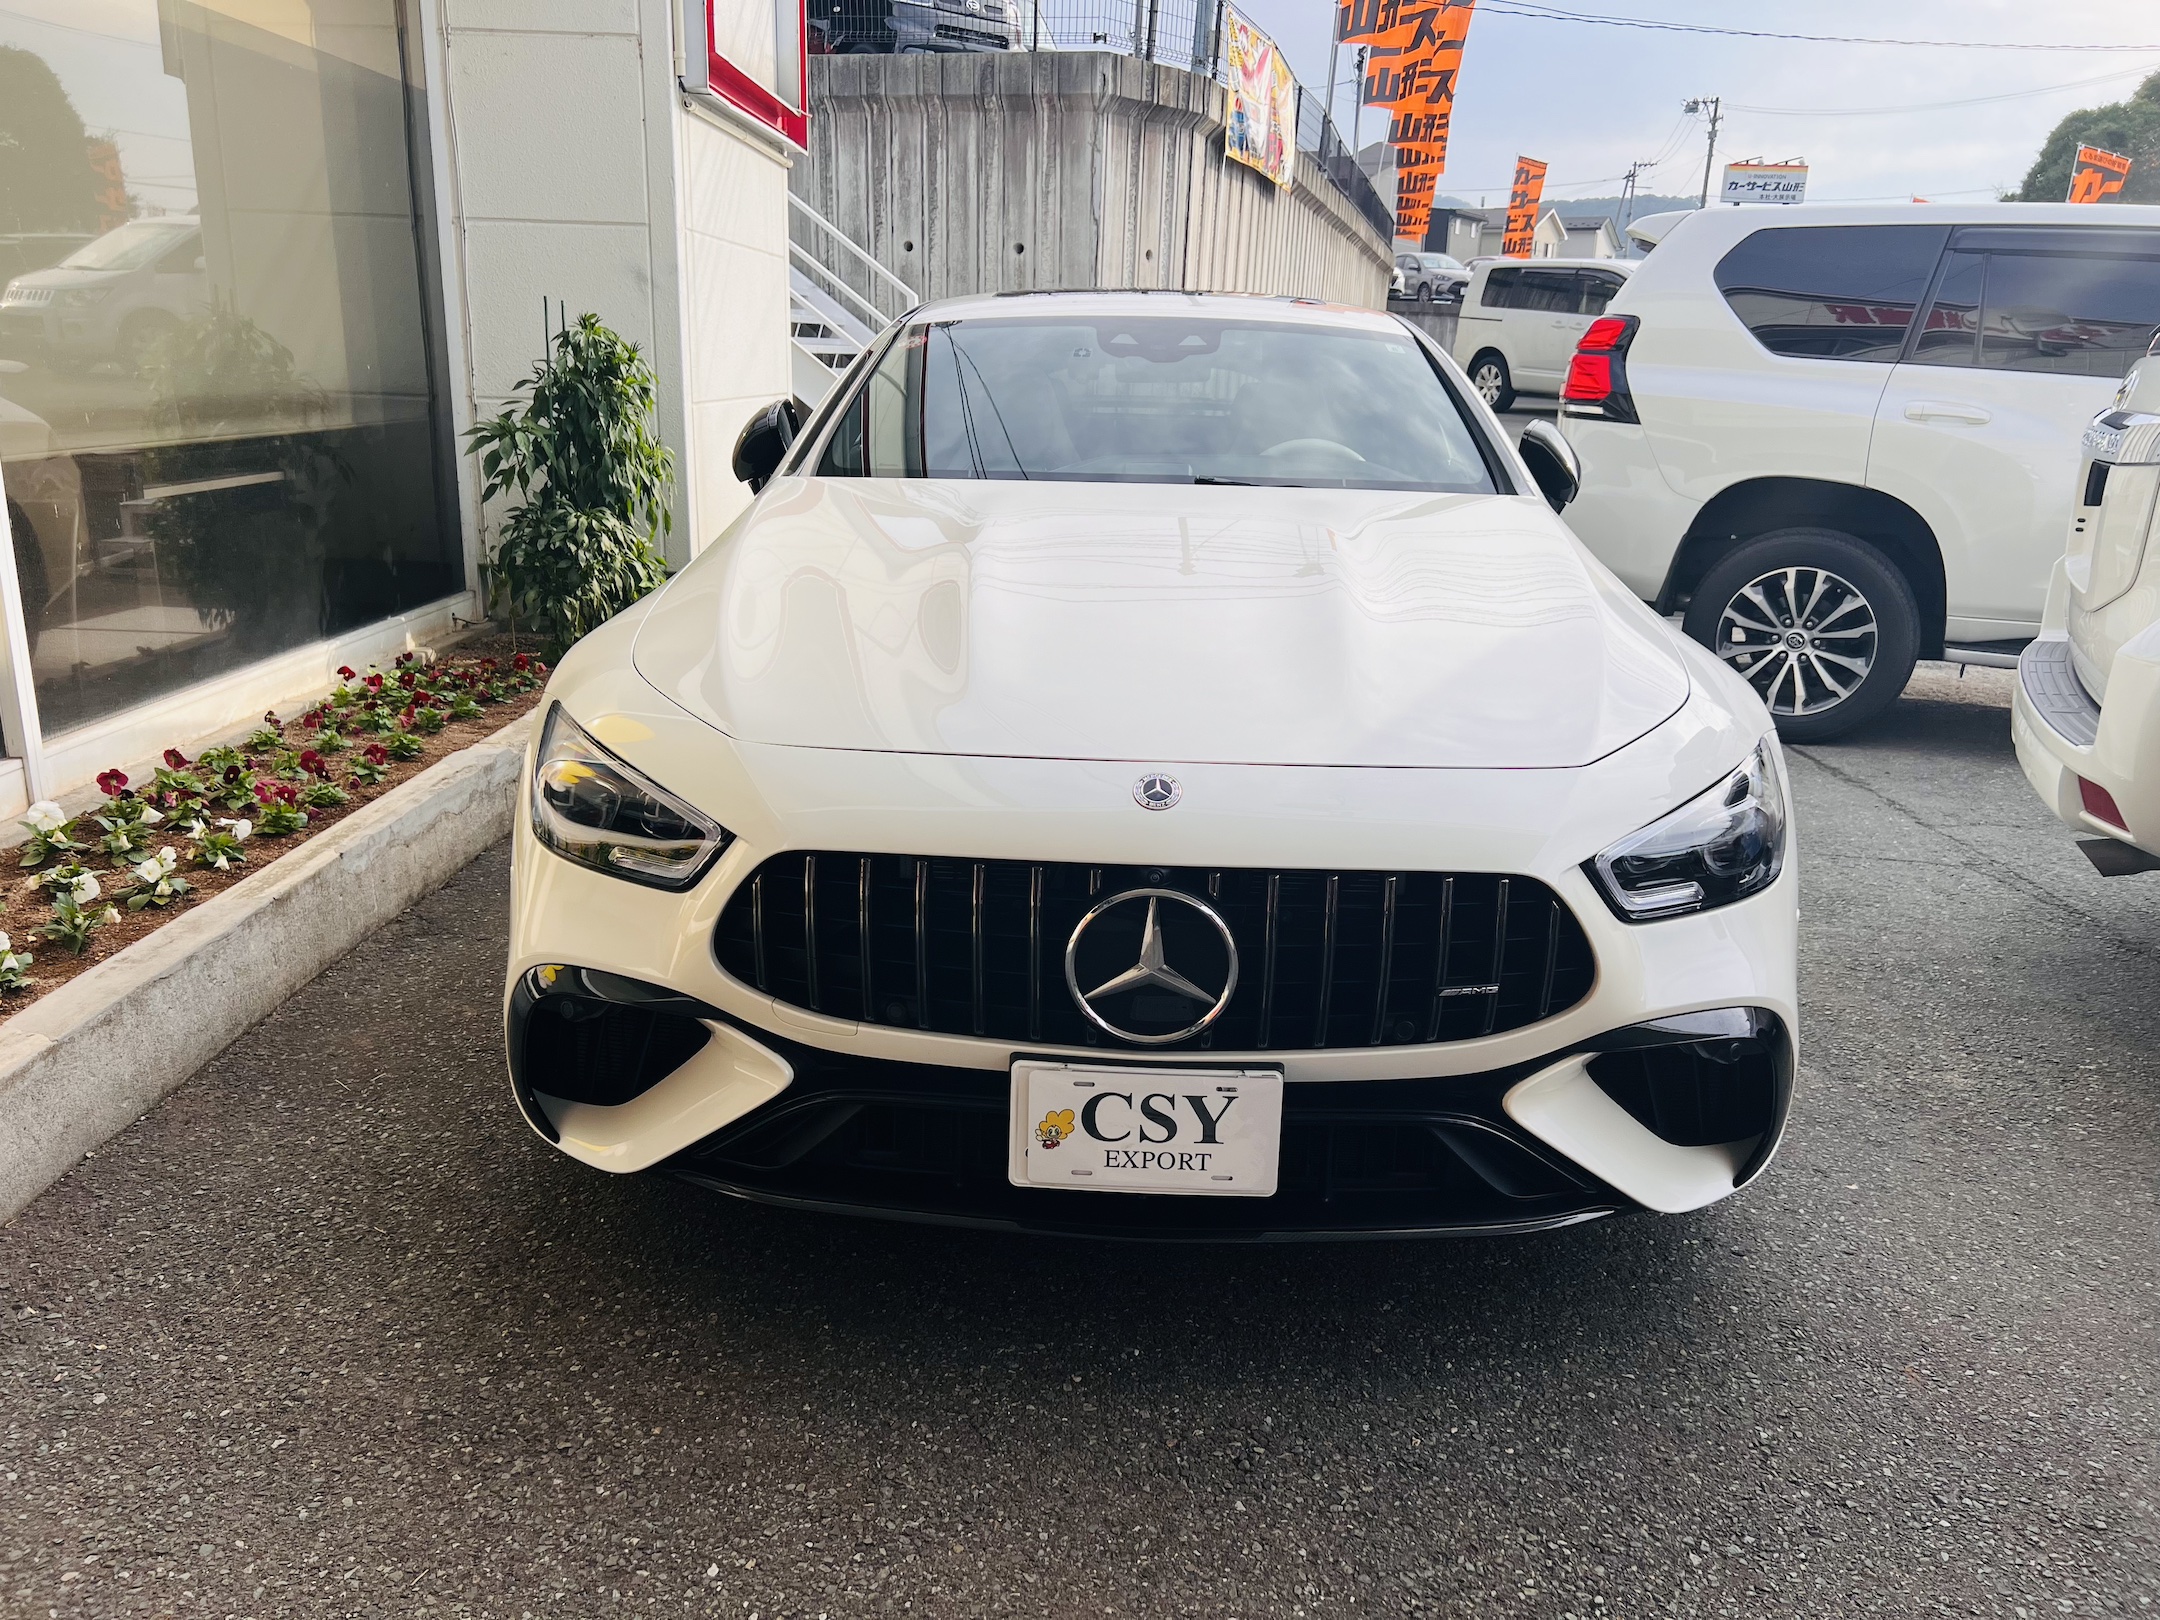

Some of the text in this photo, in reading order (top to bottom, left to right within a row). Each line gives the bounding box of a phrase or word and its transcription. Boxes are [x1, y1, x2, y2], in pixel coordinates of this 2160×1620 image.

[1728, 180, 1805, 192] カーサービス山形
[1080, 1091, 1239, 1145] CSY
[1104, 1149, 1212, 1172] EXPORT
